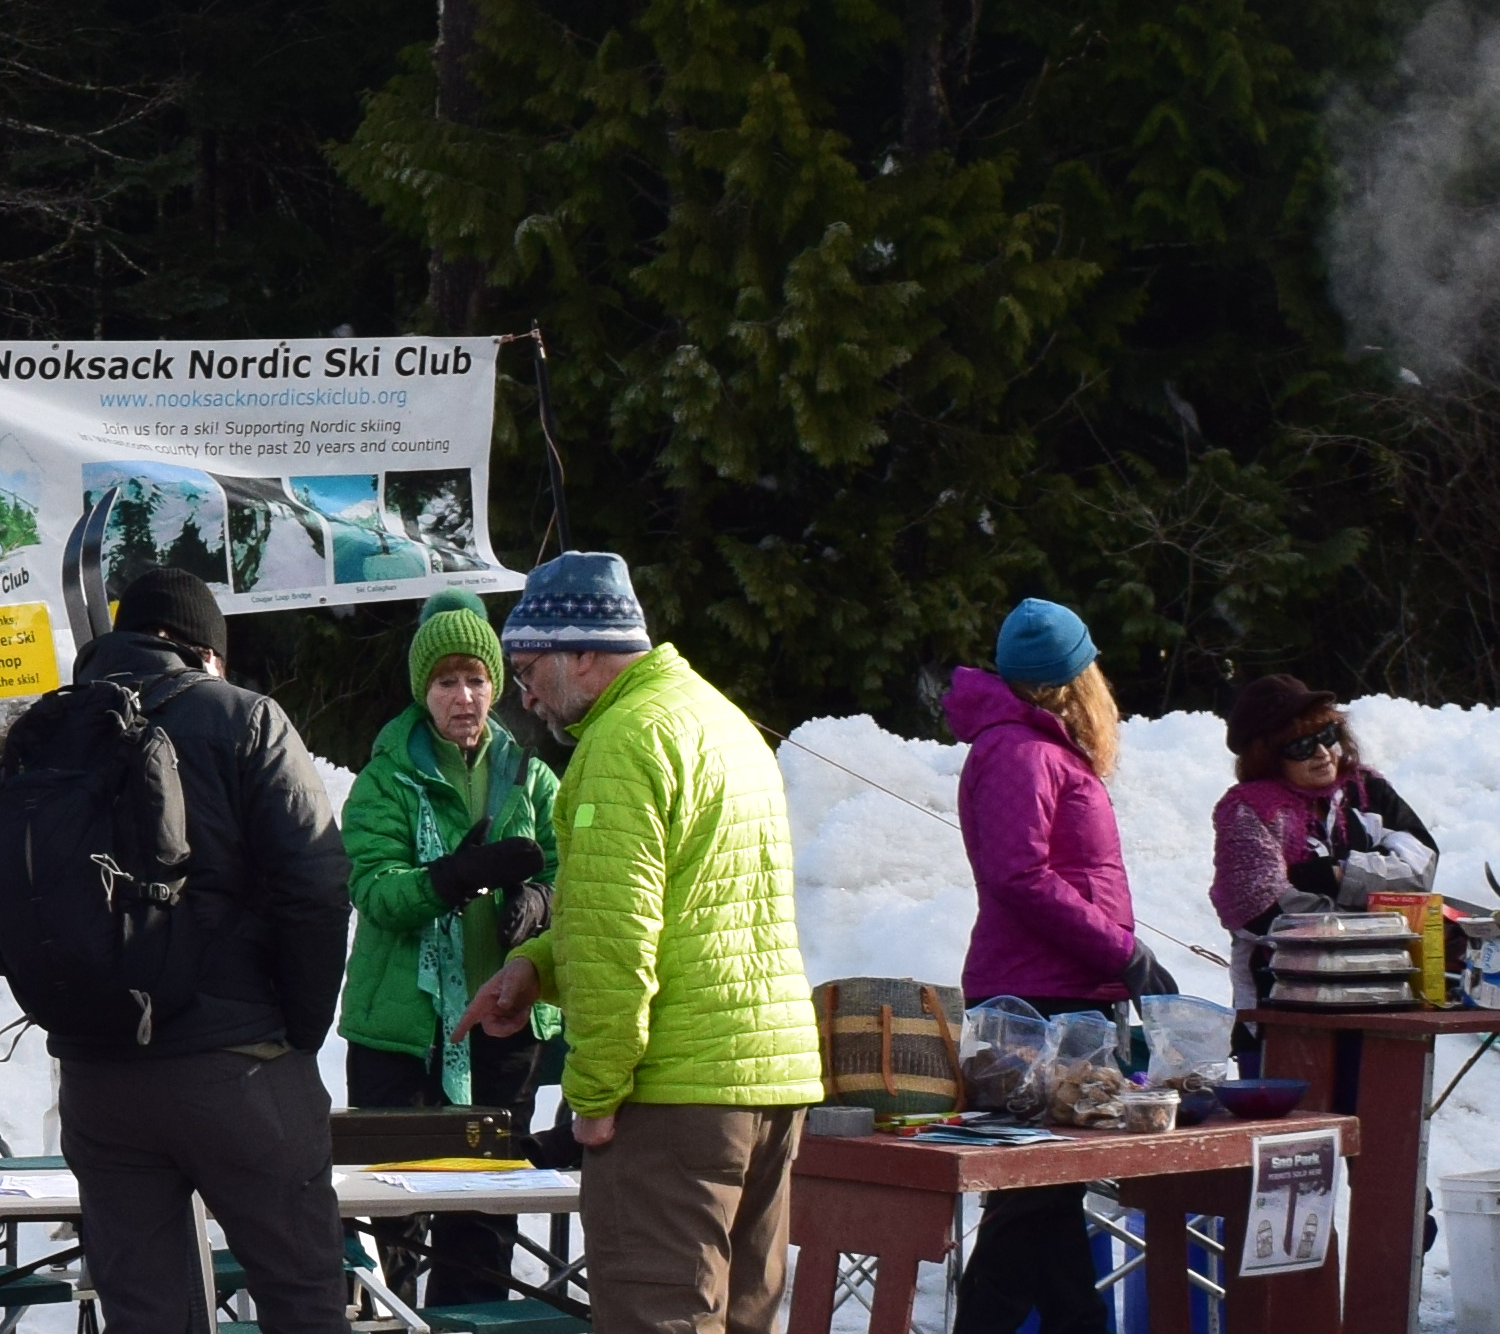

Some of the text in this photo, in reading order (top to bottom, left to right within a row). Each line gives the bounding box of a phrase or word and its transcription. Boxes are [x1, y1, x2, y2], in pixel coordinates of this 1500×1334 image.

[188, 348, 311, 380] Nordic
[324, 346, 381, 378] Ski
[394, 345, 472, 376] Club
[100, 388, 408, 409] www.nooksacknordicskiclub.org
[102, 419, 401, 437] Join us for a ski! Supporting Nordic skiing
[155, 444, 199, 458] county
[204, 441, 224, 456] for
[229, 441, 252, 455] the
[257, 441, 288, 457] past
[293, 441, 311, 454] 20
[316, 441, 355, 456] years
[360, 439, 386, 453] and
[391, 438, 450, 453] counting
[2, 567, 30, 594] Club
[16, 630, 35, 645] Ski
[17, 672, 40, 686] skis!
[1271, 1153, 1320, 1169] Sno Park
